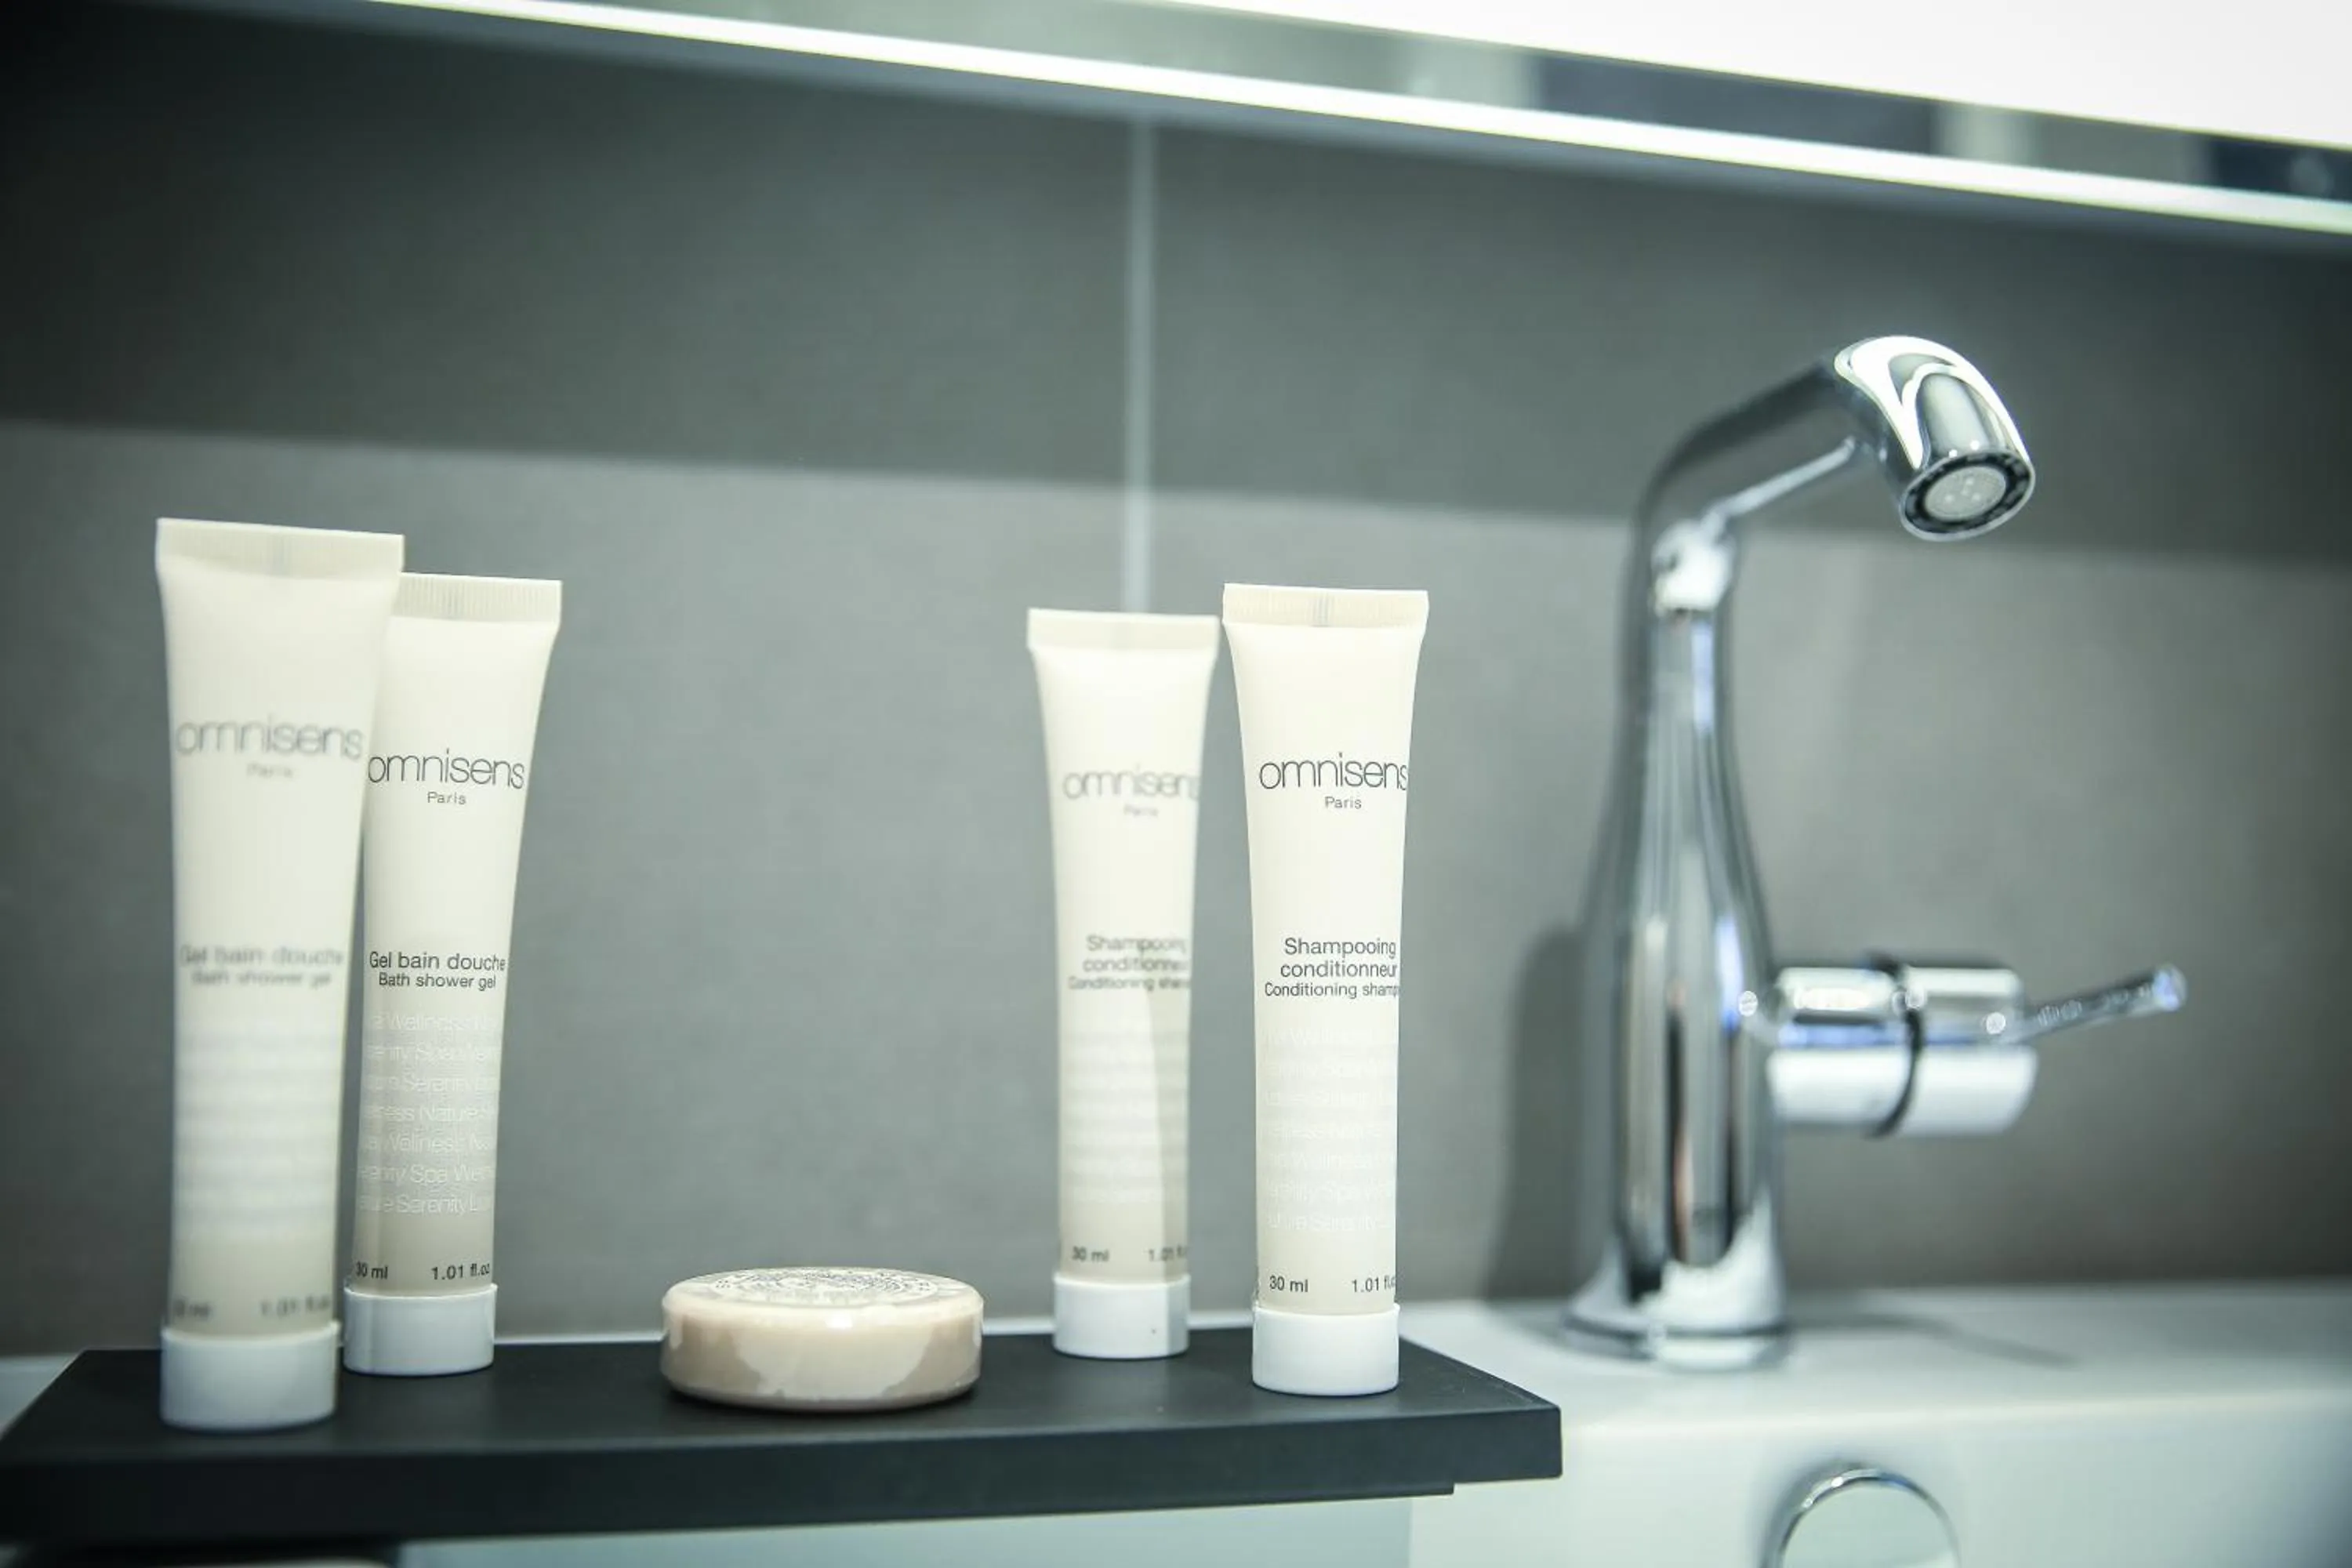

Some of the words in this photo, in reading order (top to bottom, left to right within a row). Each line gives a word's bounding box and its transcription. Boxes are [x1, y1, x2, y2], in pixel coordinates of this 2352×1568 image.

[176, 715, 363, 760] omnisens
[368, 748, 525, 789] omnisens
[1259, 752, 1407, 790] omnisens
[427, 791, 467, 805] Paris
[1325, 796, 1363, 809] Paris
[1284, 937, 1397, 959] Shampooing
[369, 951, 392, 968] Gel
[398, 951, 440, 968] bain
[447, 953, 506, 971] douche
[1280, 960, 1398, 978] conditionneur
[379, 972, 410, 986] Bath
[416, 974, 474, 988] shower
[477, 976, 496, 991] gel
[1265, 982, 1357, 1000] Conditioning
[371, 1266, 388, 1279] ml
[432, 1265, 464, 1280] 1.01
[1269, 1275, 1285, 1290] 30
[1290, 1279, 1308, 1292] ml
[1352, 1277, 1379, 1293] 1.01
